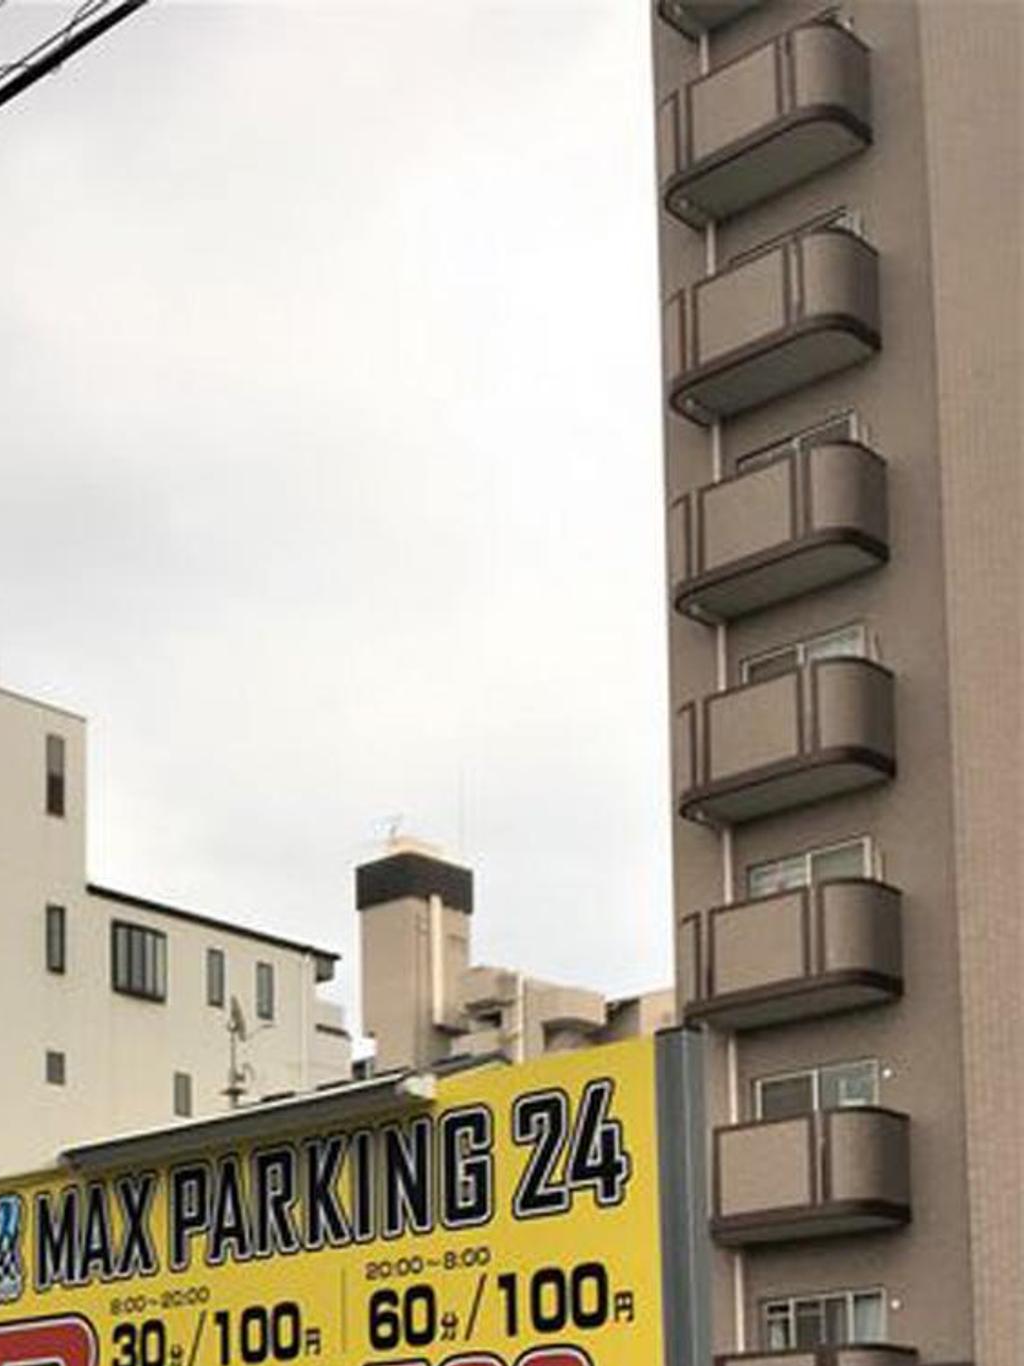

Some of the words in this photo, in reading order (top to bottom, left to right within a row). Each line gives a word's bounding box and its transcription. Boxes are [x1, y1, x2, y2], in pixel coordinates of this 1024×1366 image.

[33, 1172, 160, 1295] MAX
[168, 1102, 495, 1273] PARKING
[512, 1077, 632, 1221] 24
